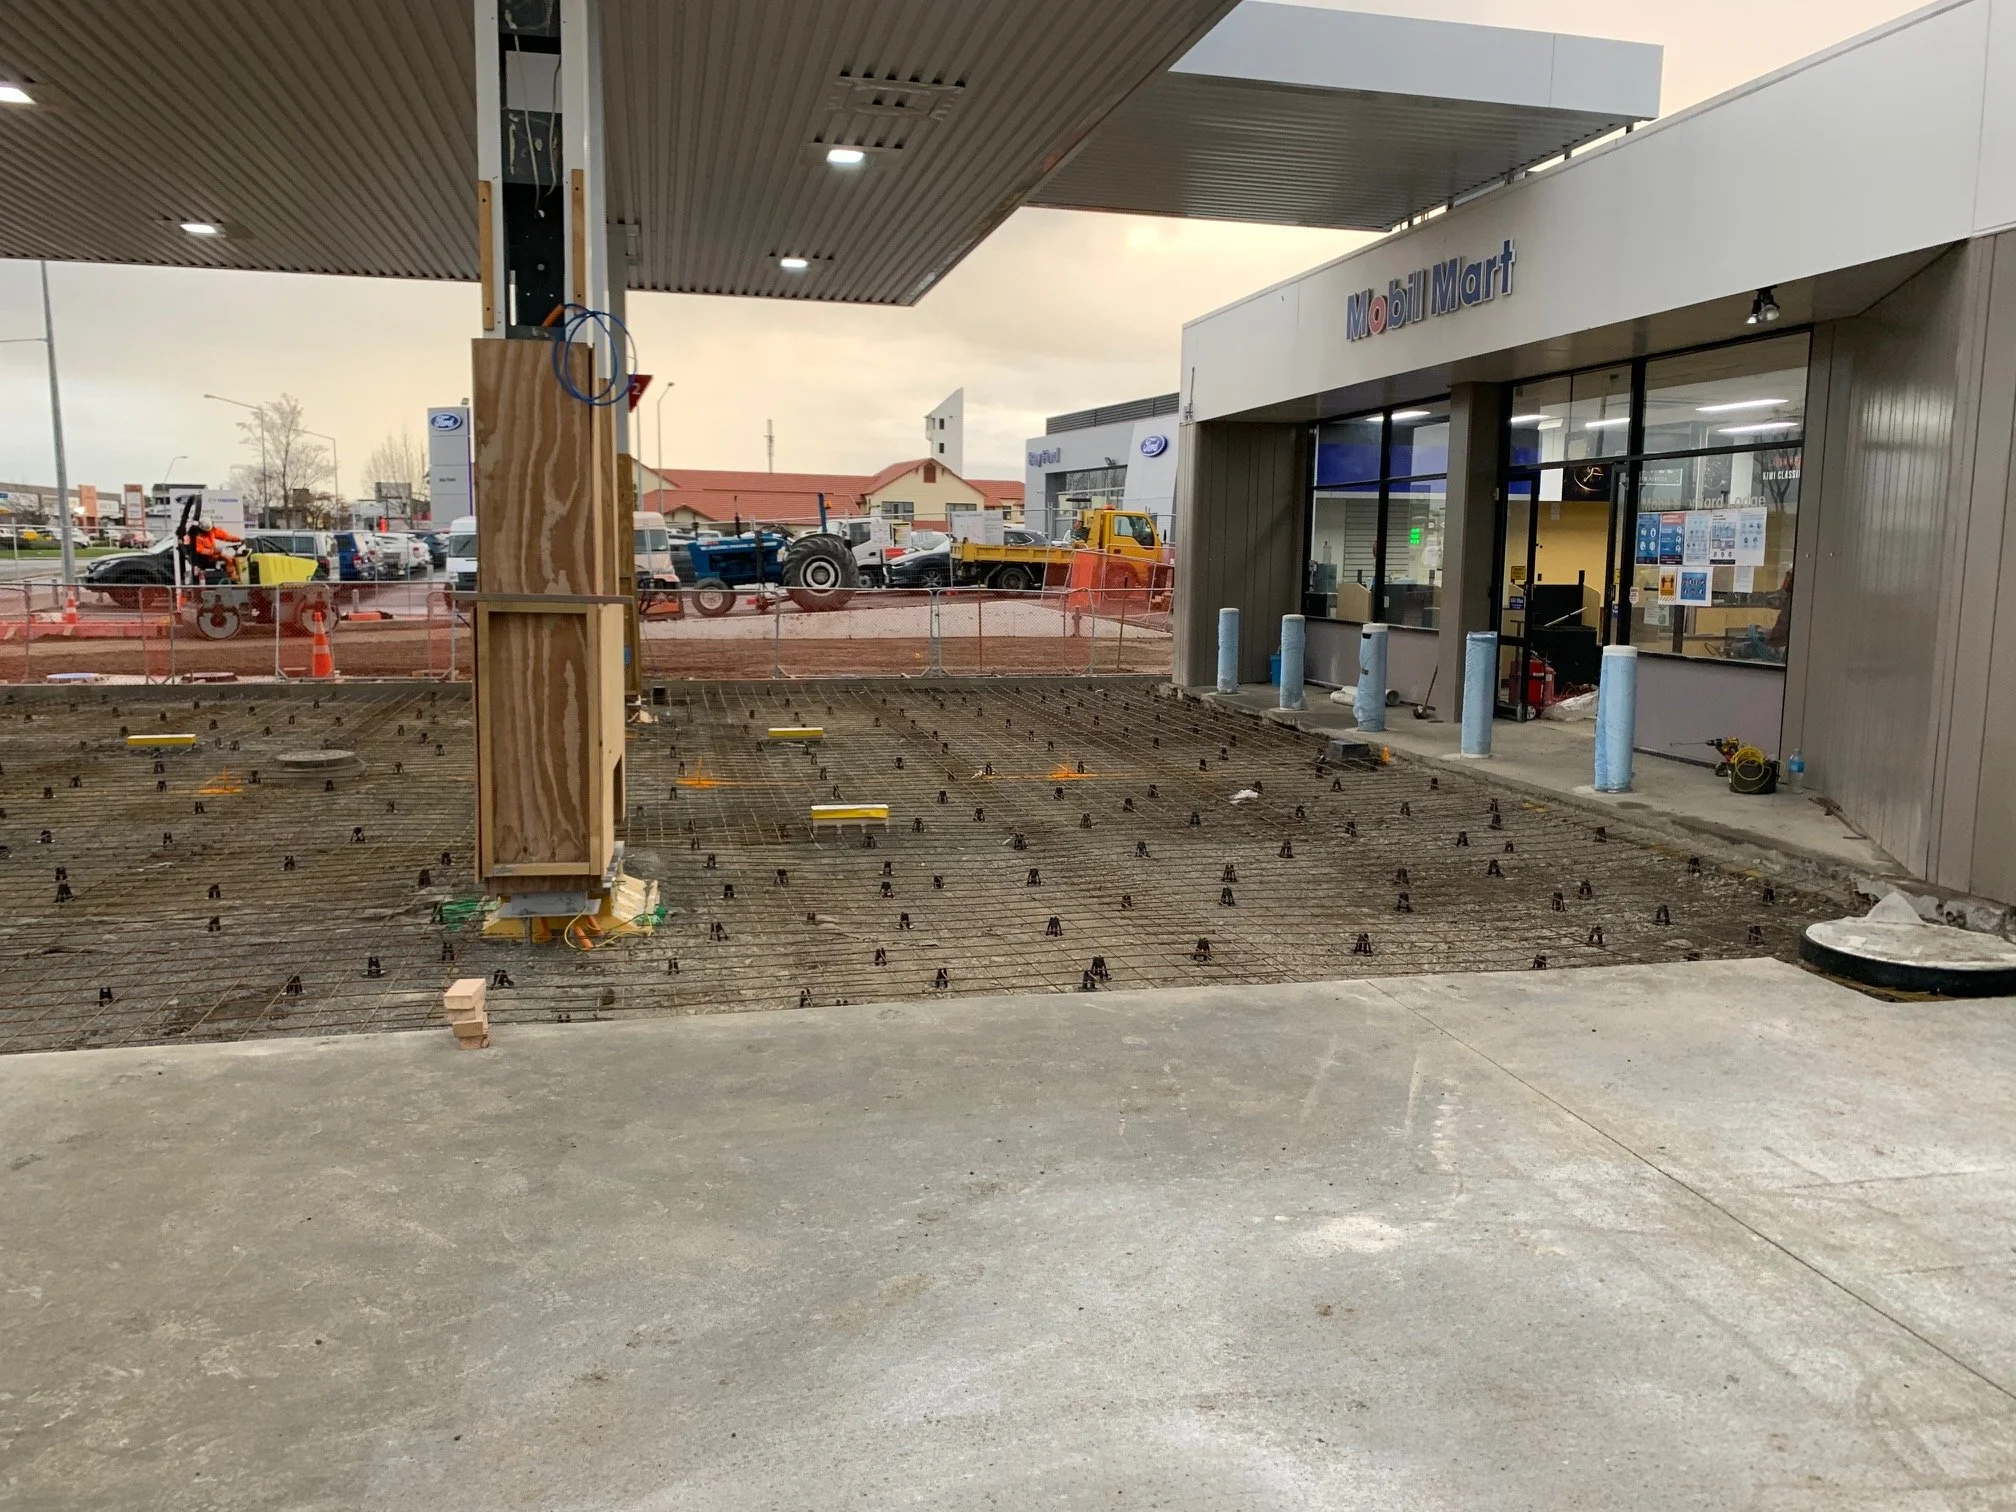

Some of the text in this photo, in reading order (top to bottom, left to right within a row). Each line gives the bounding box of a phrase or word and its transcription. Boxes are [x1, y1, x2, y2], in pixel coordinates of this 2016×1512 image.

[1346, 238, 1515, 341] Mobil Mart
[631, 383, 641, 395] 2
[432, 414, 459, 429] Ford
[1142, 437, 1162, 453] Ford
[1763, 471, 1776, 480] KIWI
